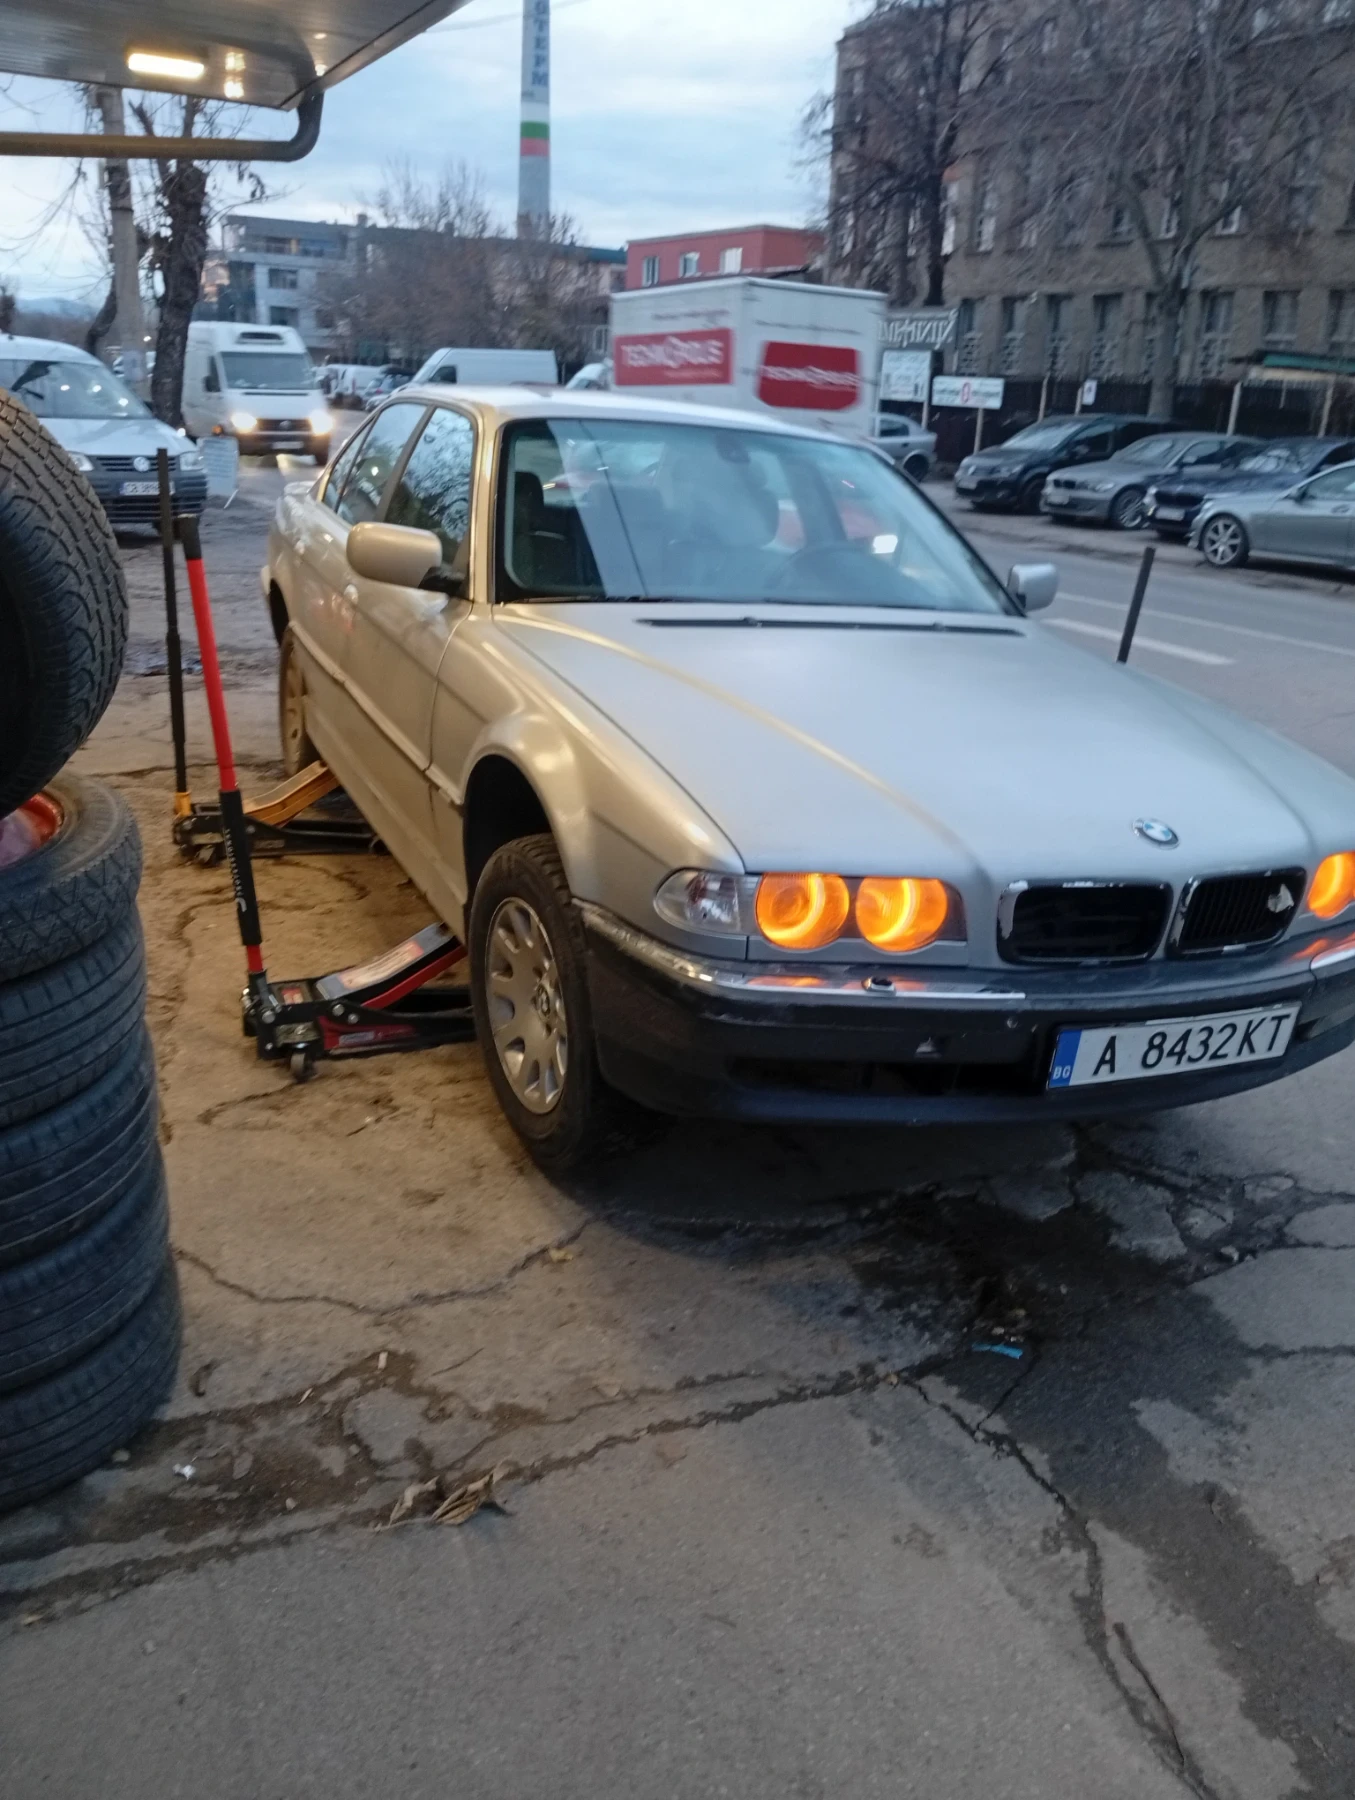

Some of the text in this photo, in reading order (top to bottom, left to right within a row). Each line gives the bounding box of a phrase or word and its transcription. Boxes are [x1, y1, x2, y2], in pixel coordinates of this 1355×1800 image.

[1052, 1014, 1292, 1080] BG A 8432KT
